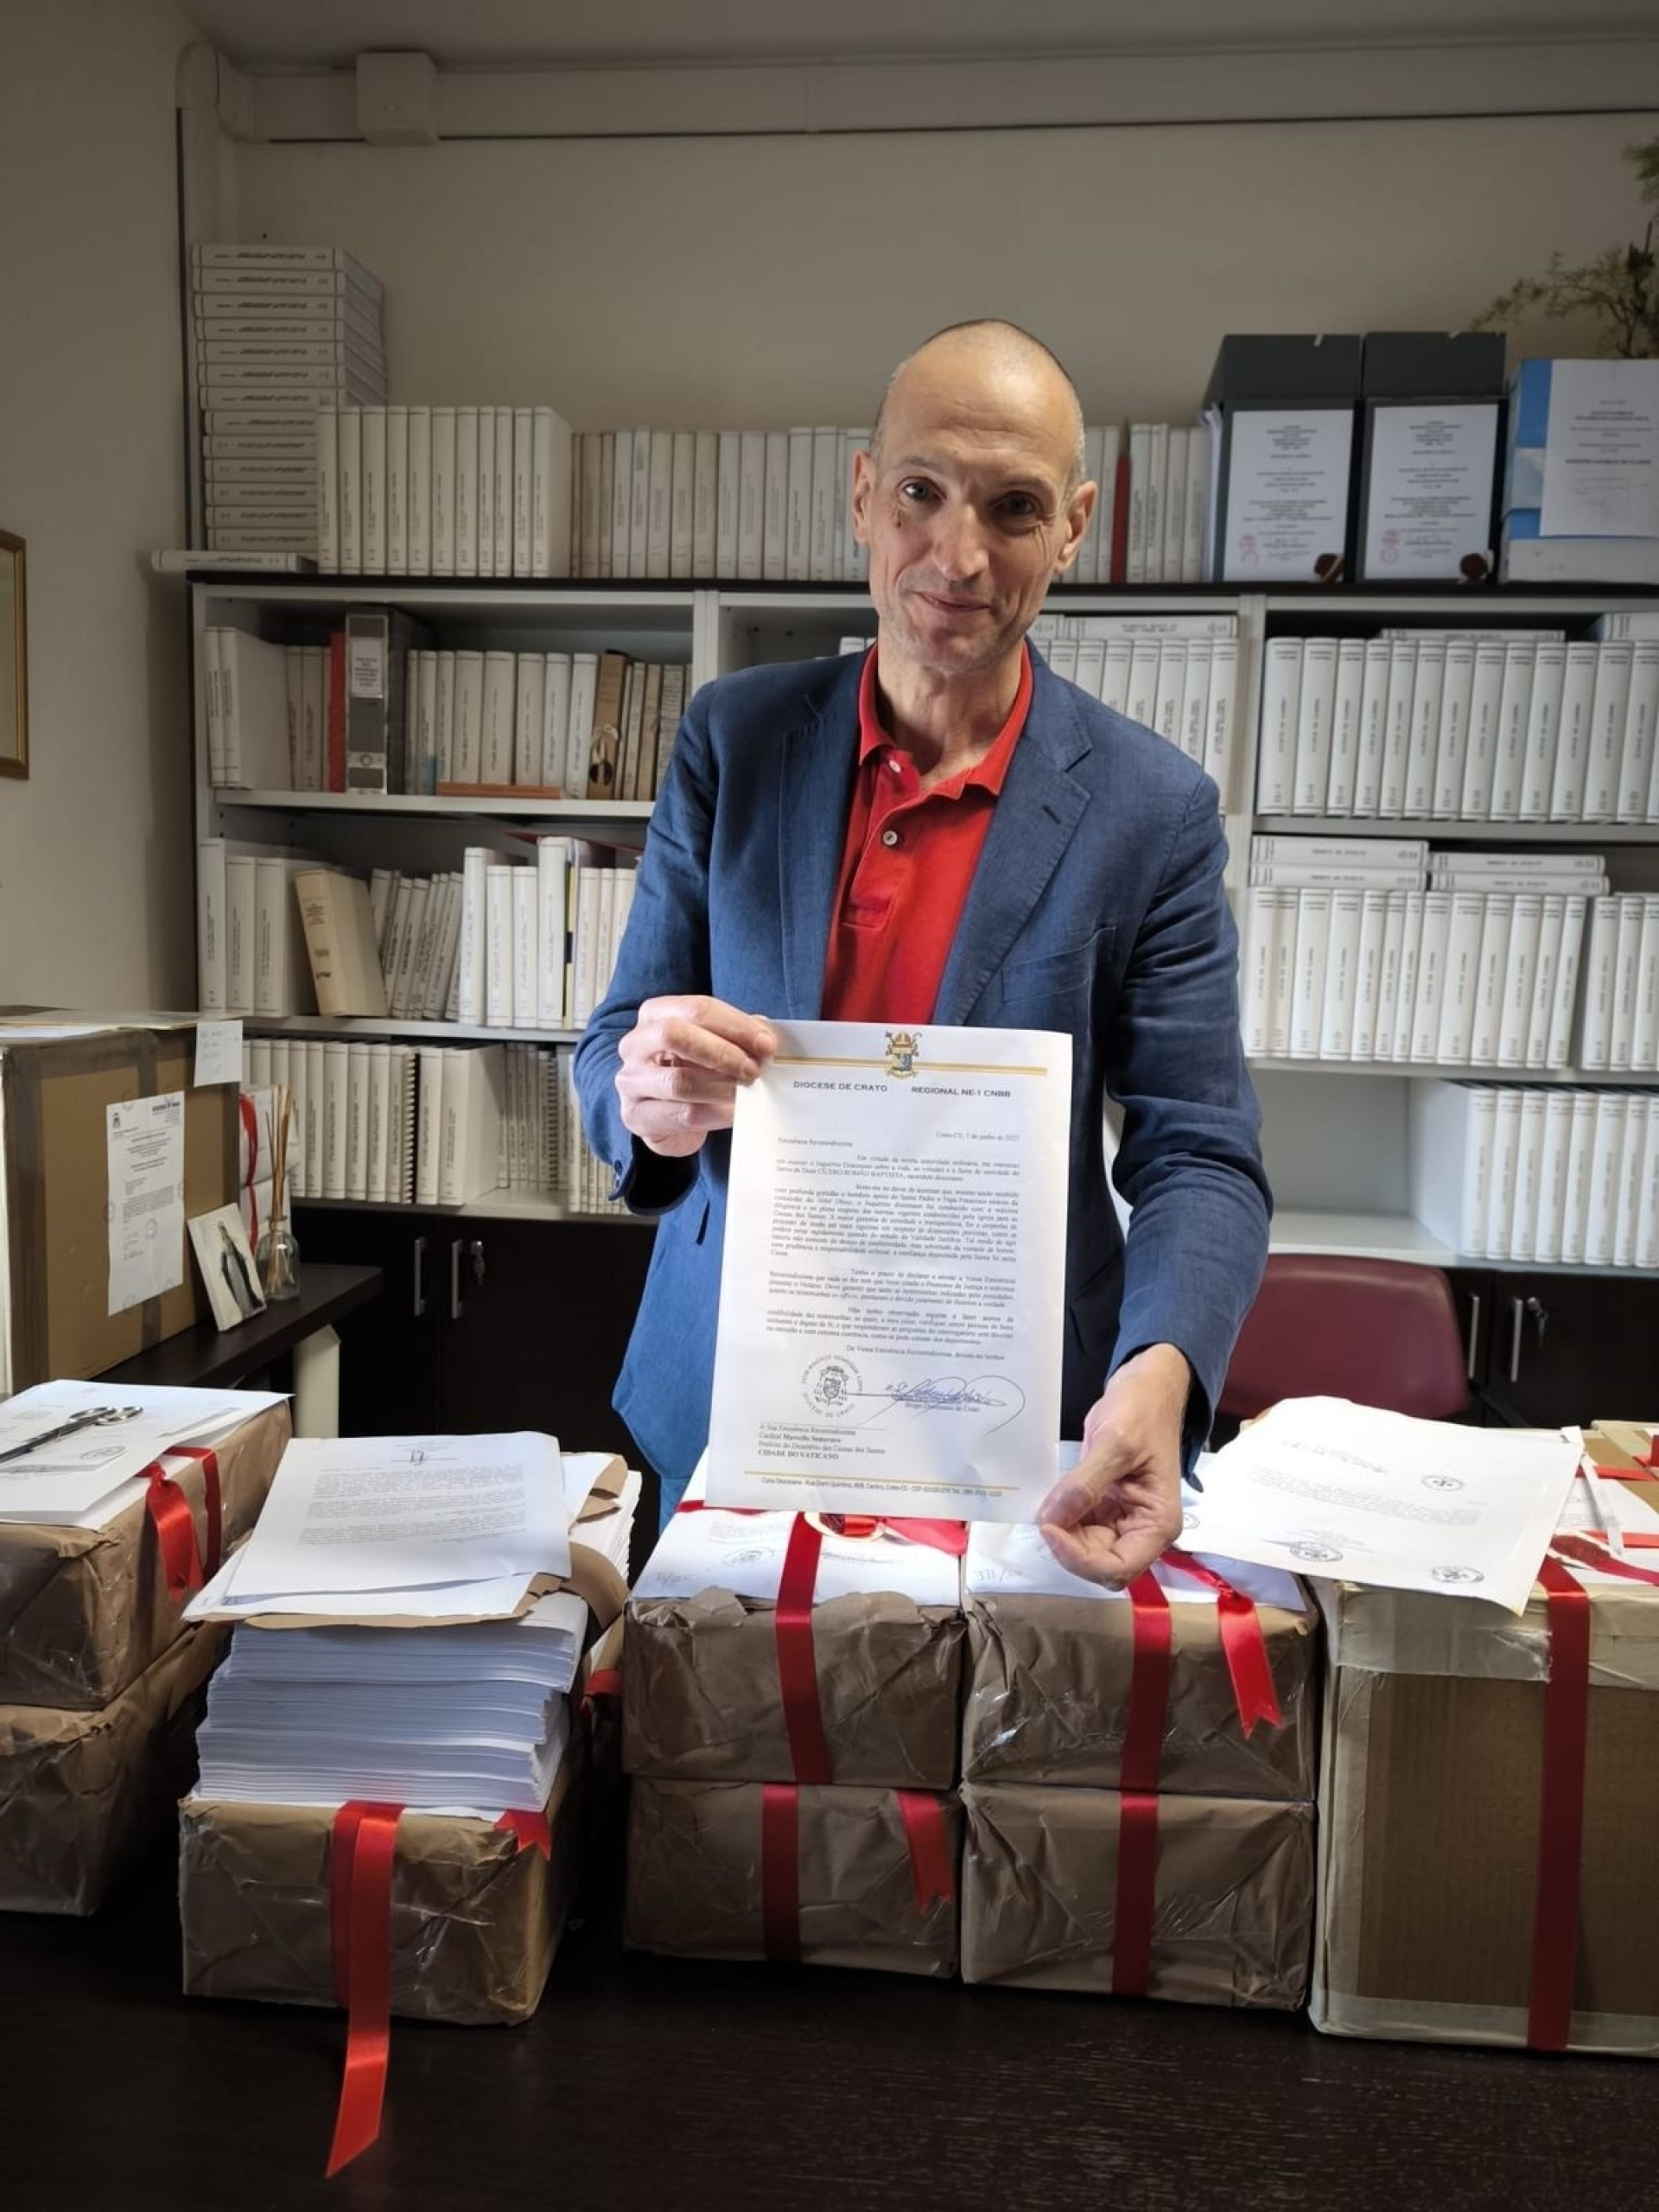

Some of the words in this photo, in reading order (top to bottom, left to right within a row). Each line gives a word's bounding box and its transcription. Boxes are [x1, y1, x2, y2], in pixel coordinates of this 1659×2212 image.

[793, 1081, 836, 1090] DIOCESE
[839, 1082, 852, 1090] DE
[854, 1084, 887, 1092] CRATO
[912, 1086, 959, 1096] REGIONAL
[758, 1449, 785, 1458] CIDADE
[800, 1452, 839, 1460] VATICANO
